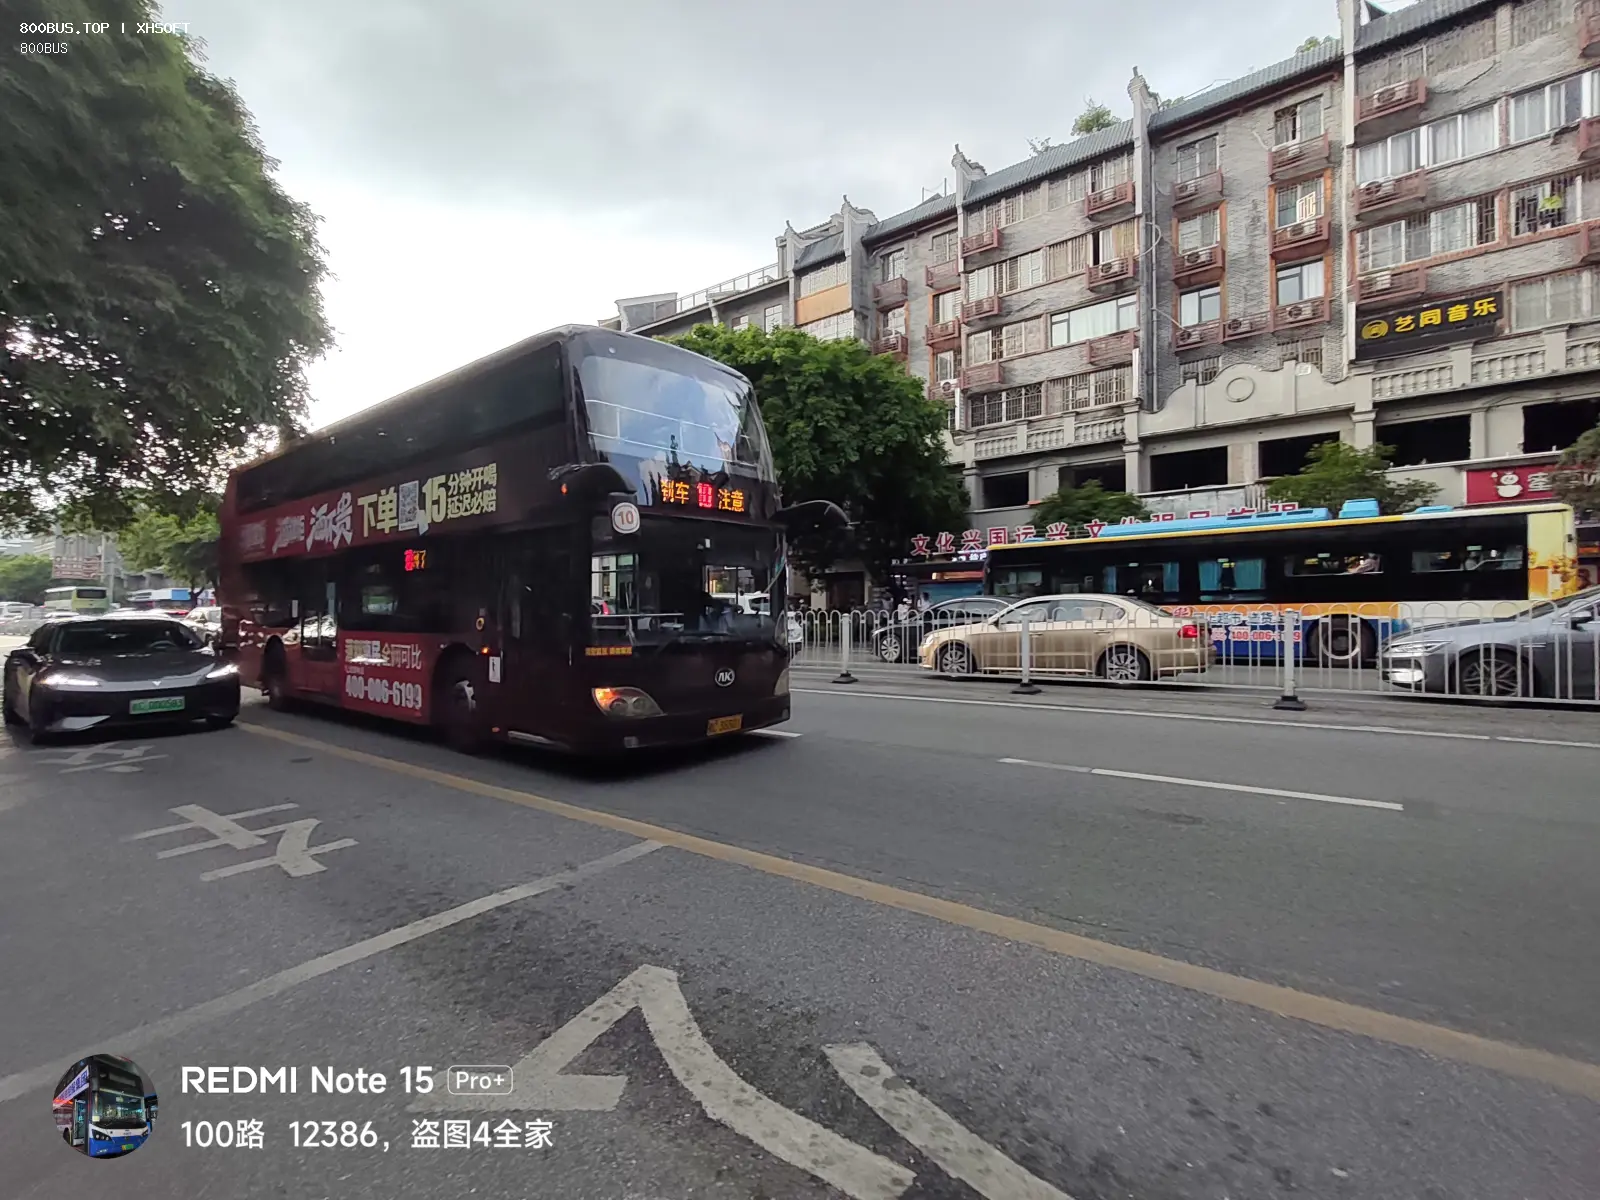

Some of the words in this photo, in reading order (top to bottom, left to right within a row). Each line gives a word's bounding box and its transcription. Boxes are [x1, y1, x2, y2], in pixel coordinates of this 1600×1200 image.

[1394, 297, 1497, 333] 艺同音乐
[357, 487, 398, 538] 下单
[422, 475, 447, 524] 15
[717, 488, 745, 512] 注意
[618, 510, 635, 525] 10
